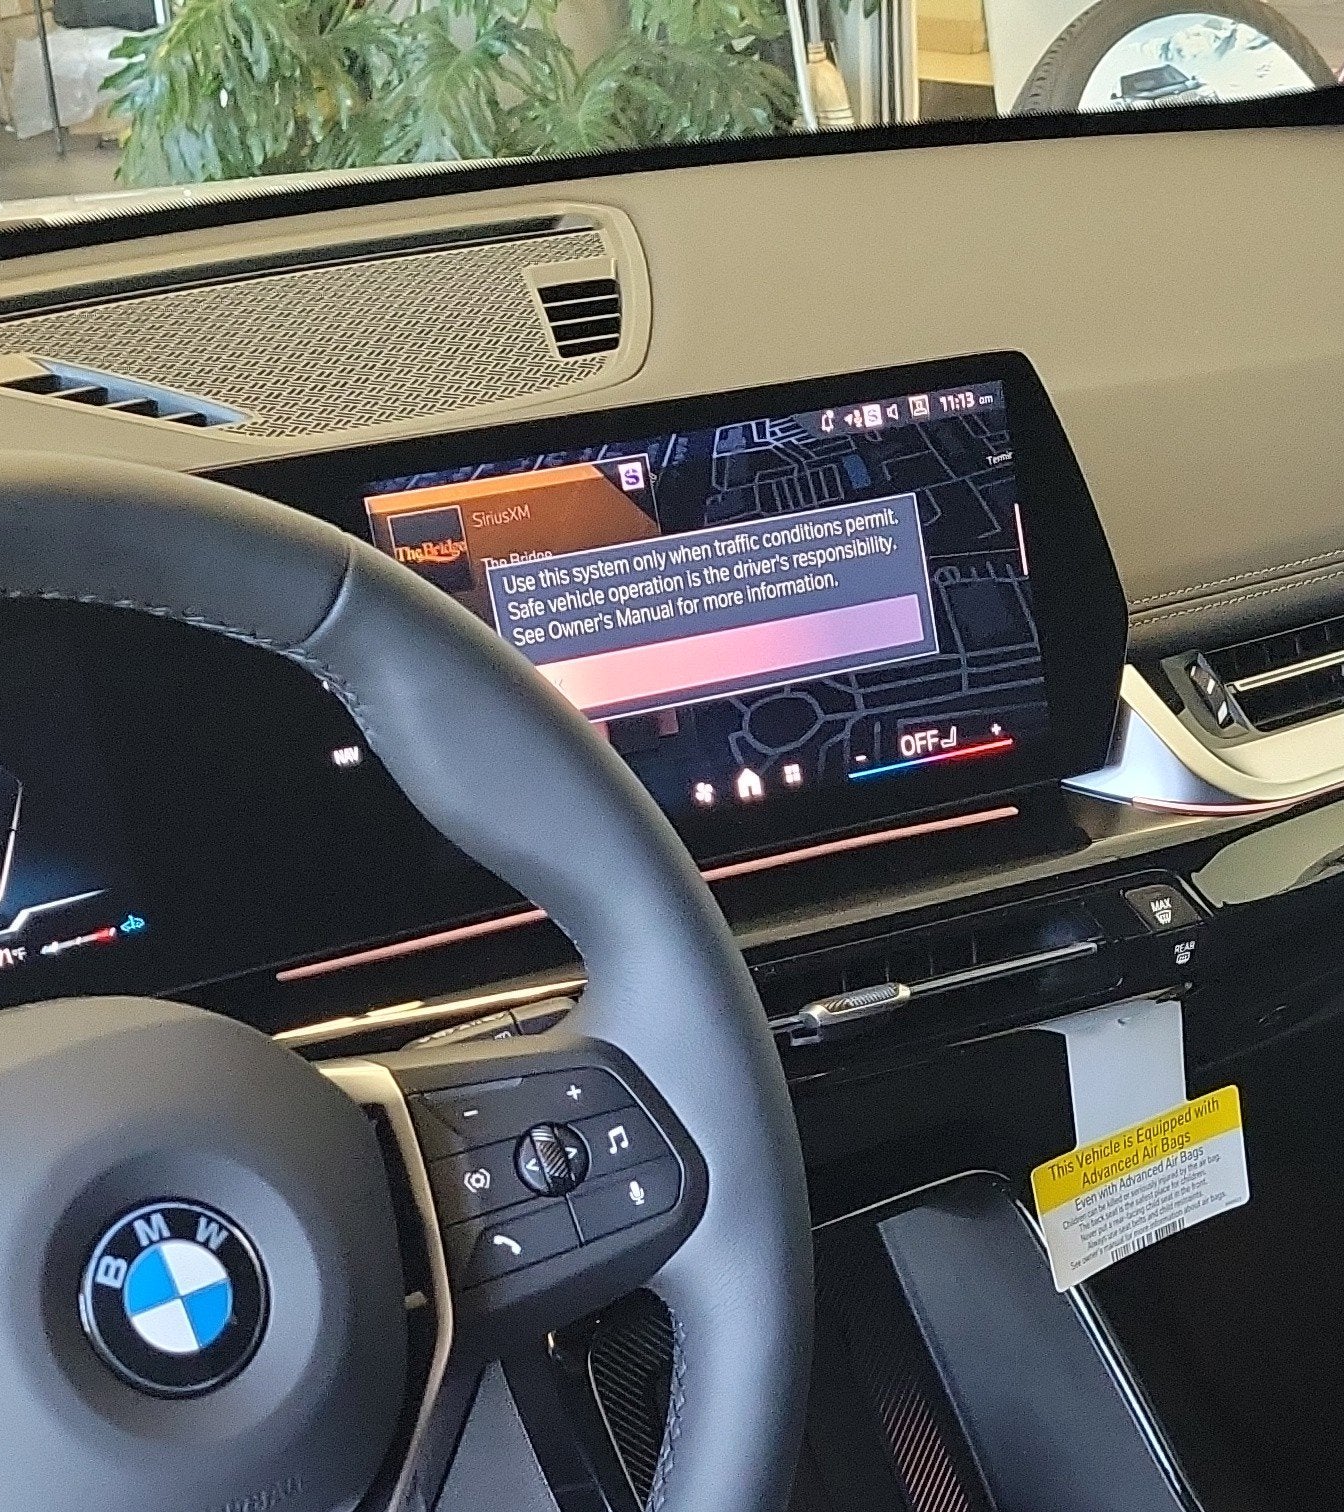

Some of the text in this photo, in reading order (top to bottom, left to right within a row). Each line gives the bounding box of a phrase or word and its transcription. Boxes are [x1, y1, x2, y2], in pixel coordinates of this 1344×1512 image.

[940, 392, 975, 412] 11:13
[979, 395, 993, 404] am
[472, 504, 531, 528] SiriusXM
[502, 508, 899, 595] Use this system only when traffic conditions permit.
[508, 536, 898, 621] Safe vehicle operation is the driver's responsibility.
[513, 573, 839, 647] See Owner's Manual for more information.
[900, 730, 939, 756] OFF
[1150, 898, 1172, 912] MAX
[1174, 941, 1196, 954] REAR
[1048, 1097, 1219, 1181] This Vehicle is Equipped with
[1082, 1131, 1191, 1188] Advanced Air Bags
[1074, 1146, 1204, 1211] Even with Advanced Air Bags
[95, 1213, 227, 1289] BMW
